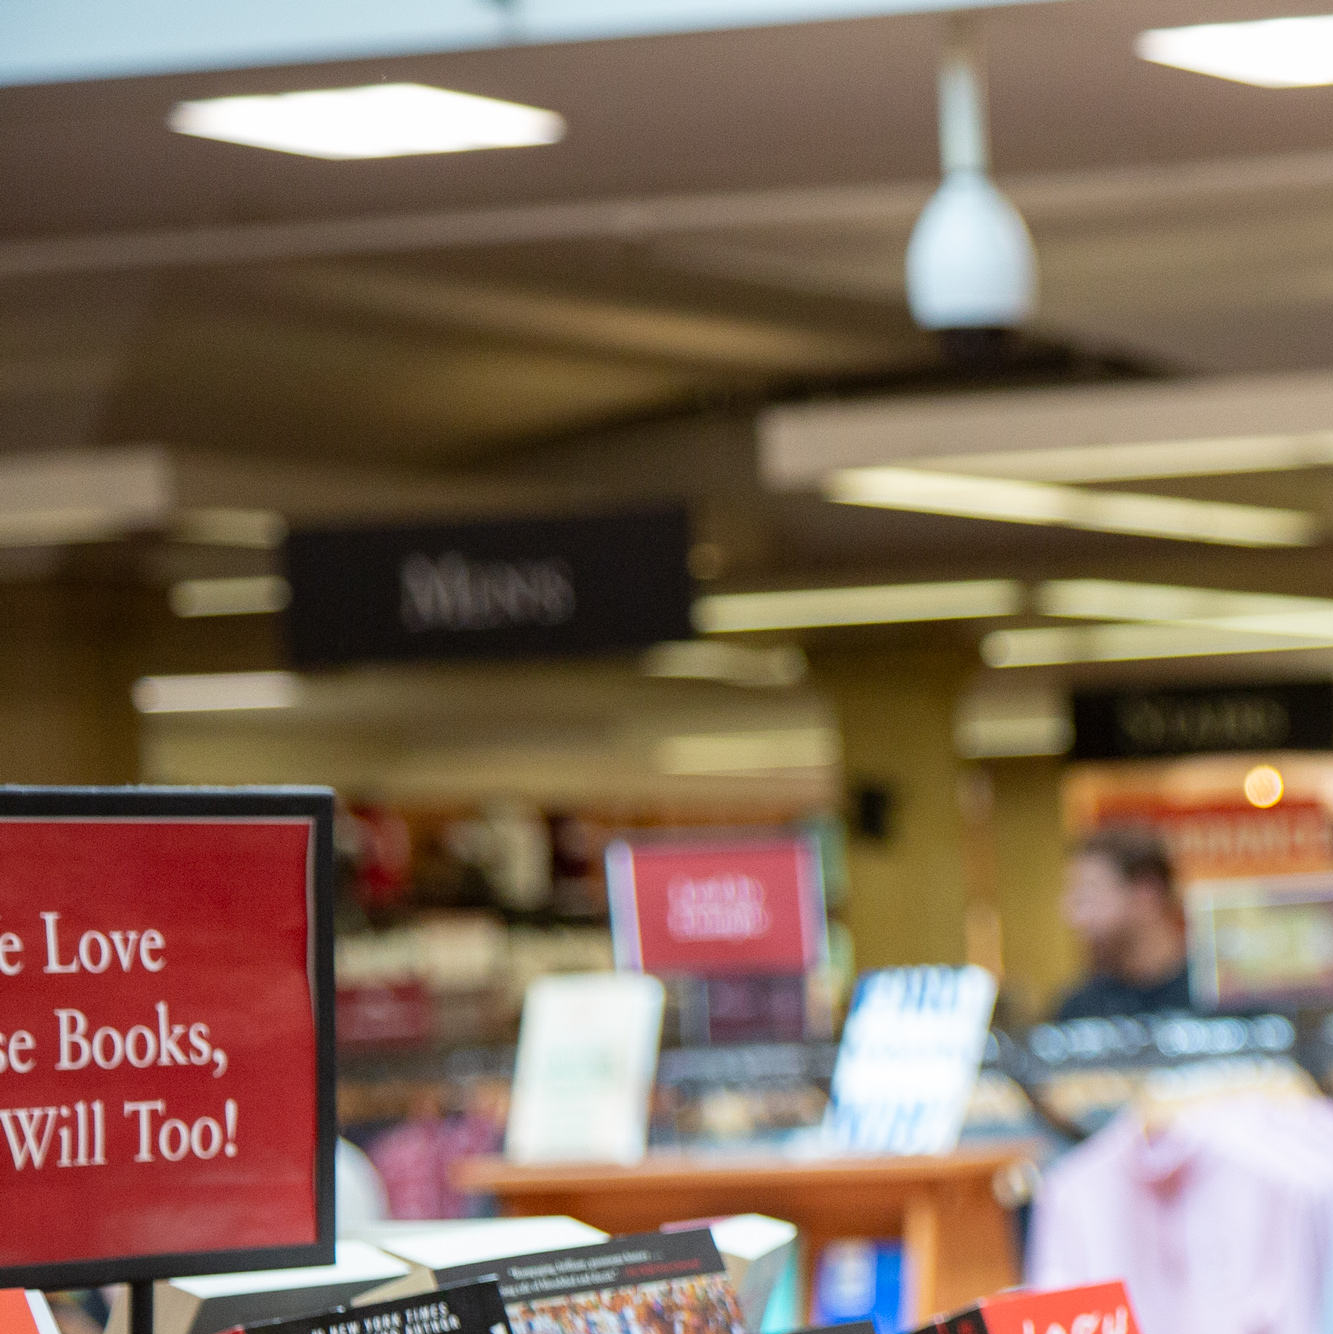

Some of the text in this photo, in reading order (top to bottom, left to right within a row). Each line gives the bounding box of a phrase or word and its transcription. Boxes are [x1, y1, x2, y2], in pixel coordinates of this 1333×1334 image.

[0, 911, 167, 975] e Love
[54, 1002, 228, 1077] Books,
[0, 1100, 239, 1170] Will Too!
[364, 1310, 401, 1332] YORK
[405, 1301, 449, 1323] TIMES
